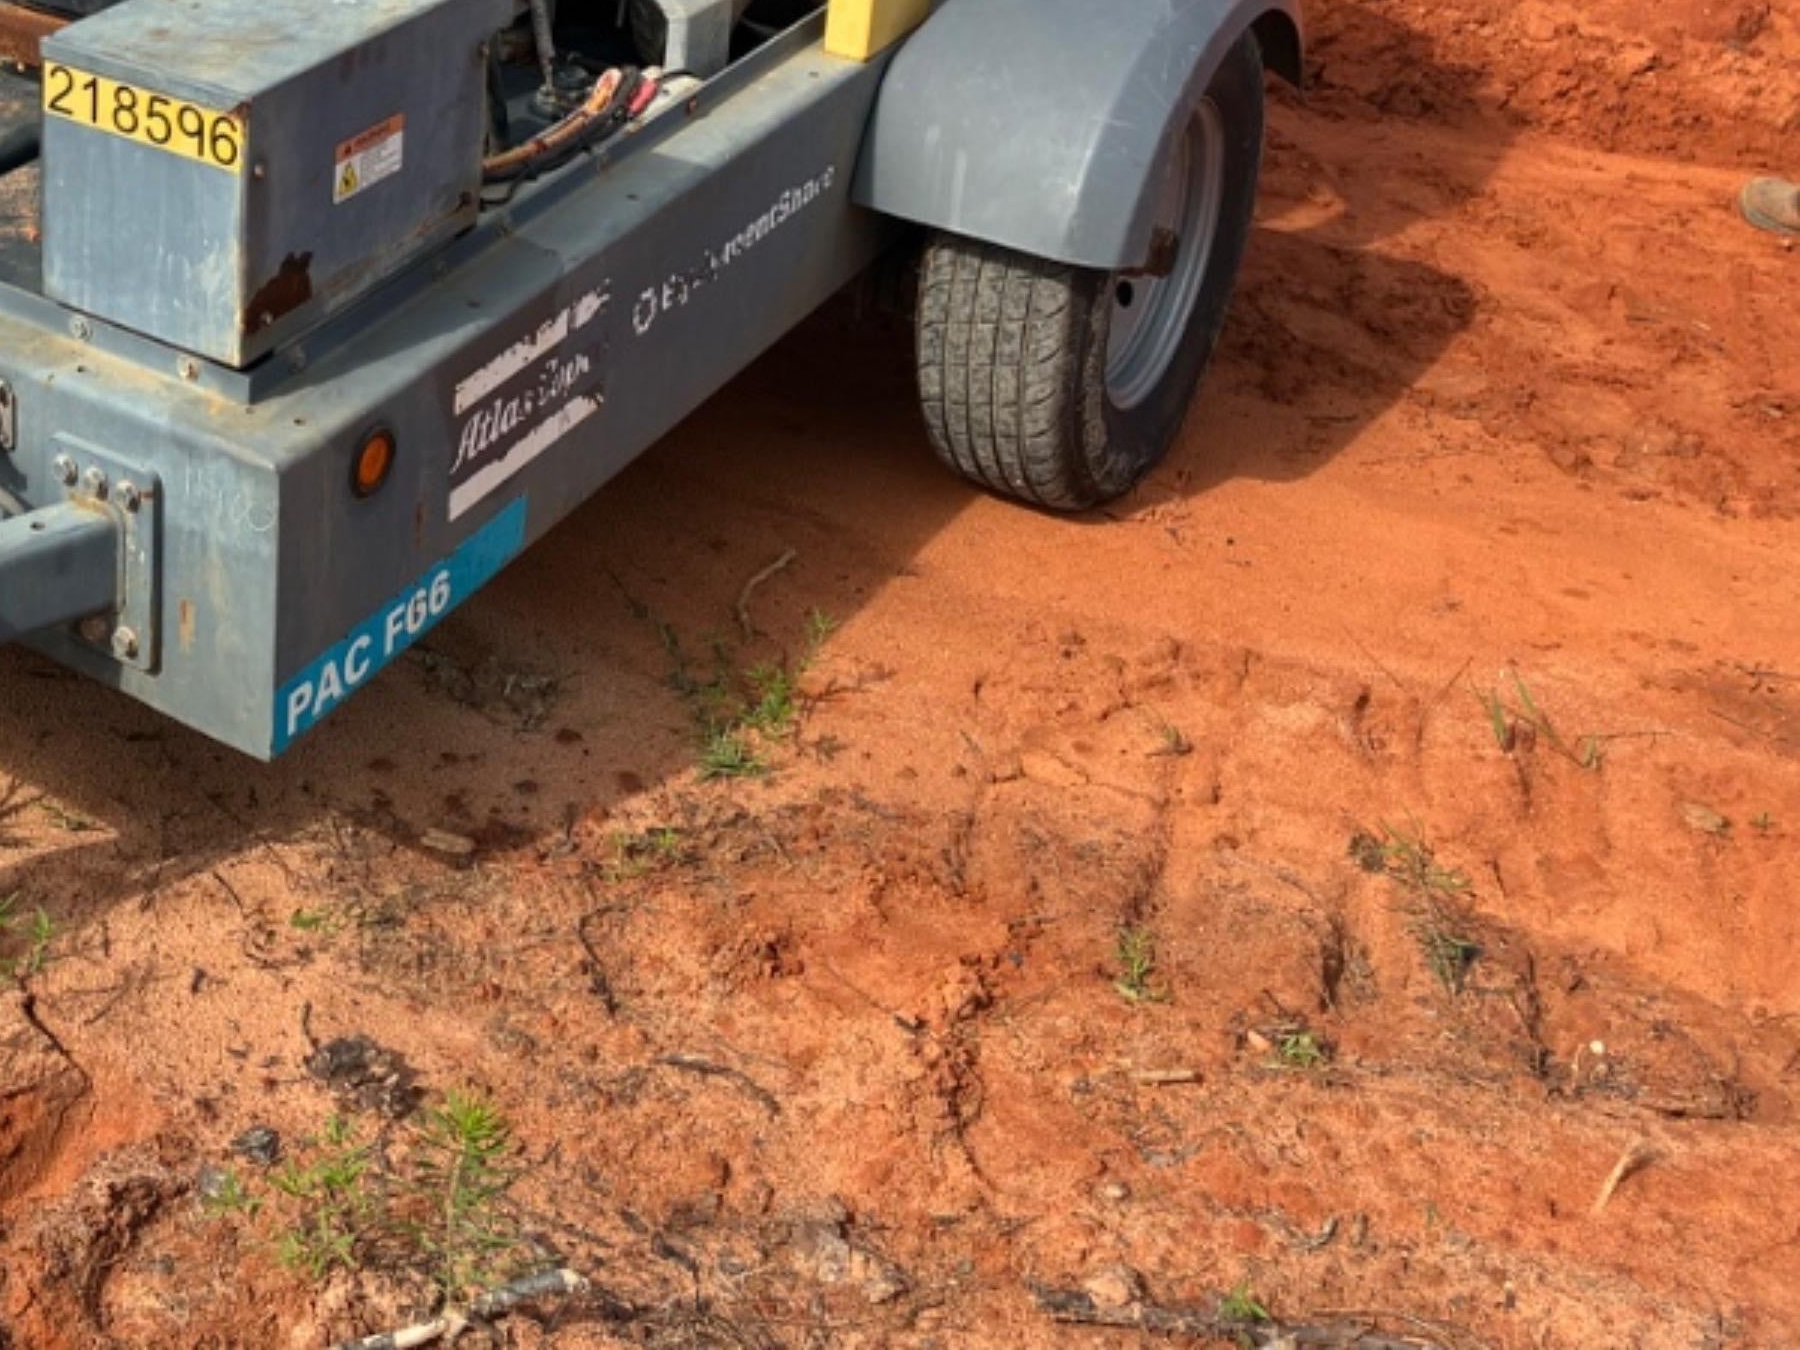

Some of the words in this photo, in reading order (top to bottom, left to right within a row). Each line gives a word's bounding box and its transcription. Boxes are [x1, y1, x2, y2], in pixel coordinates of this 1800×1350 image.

[48, 65, 238, 166] 218596
[286, 634, 372, 738] PAC
[384, 569, 451, 657] F66
